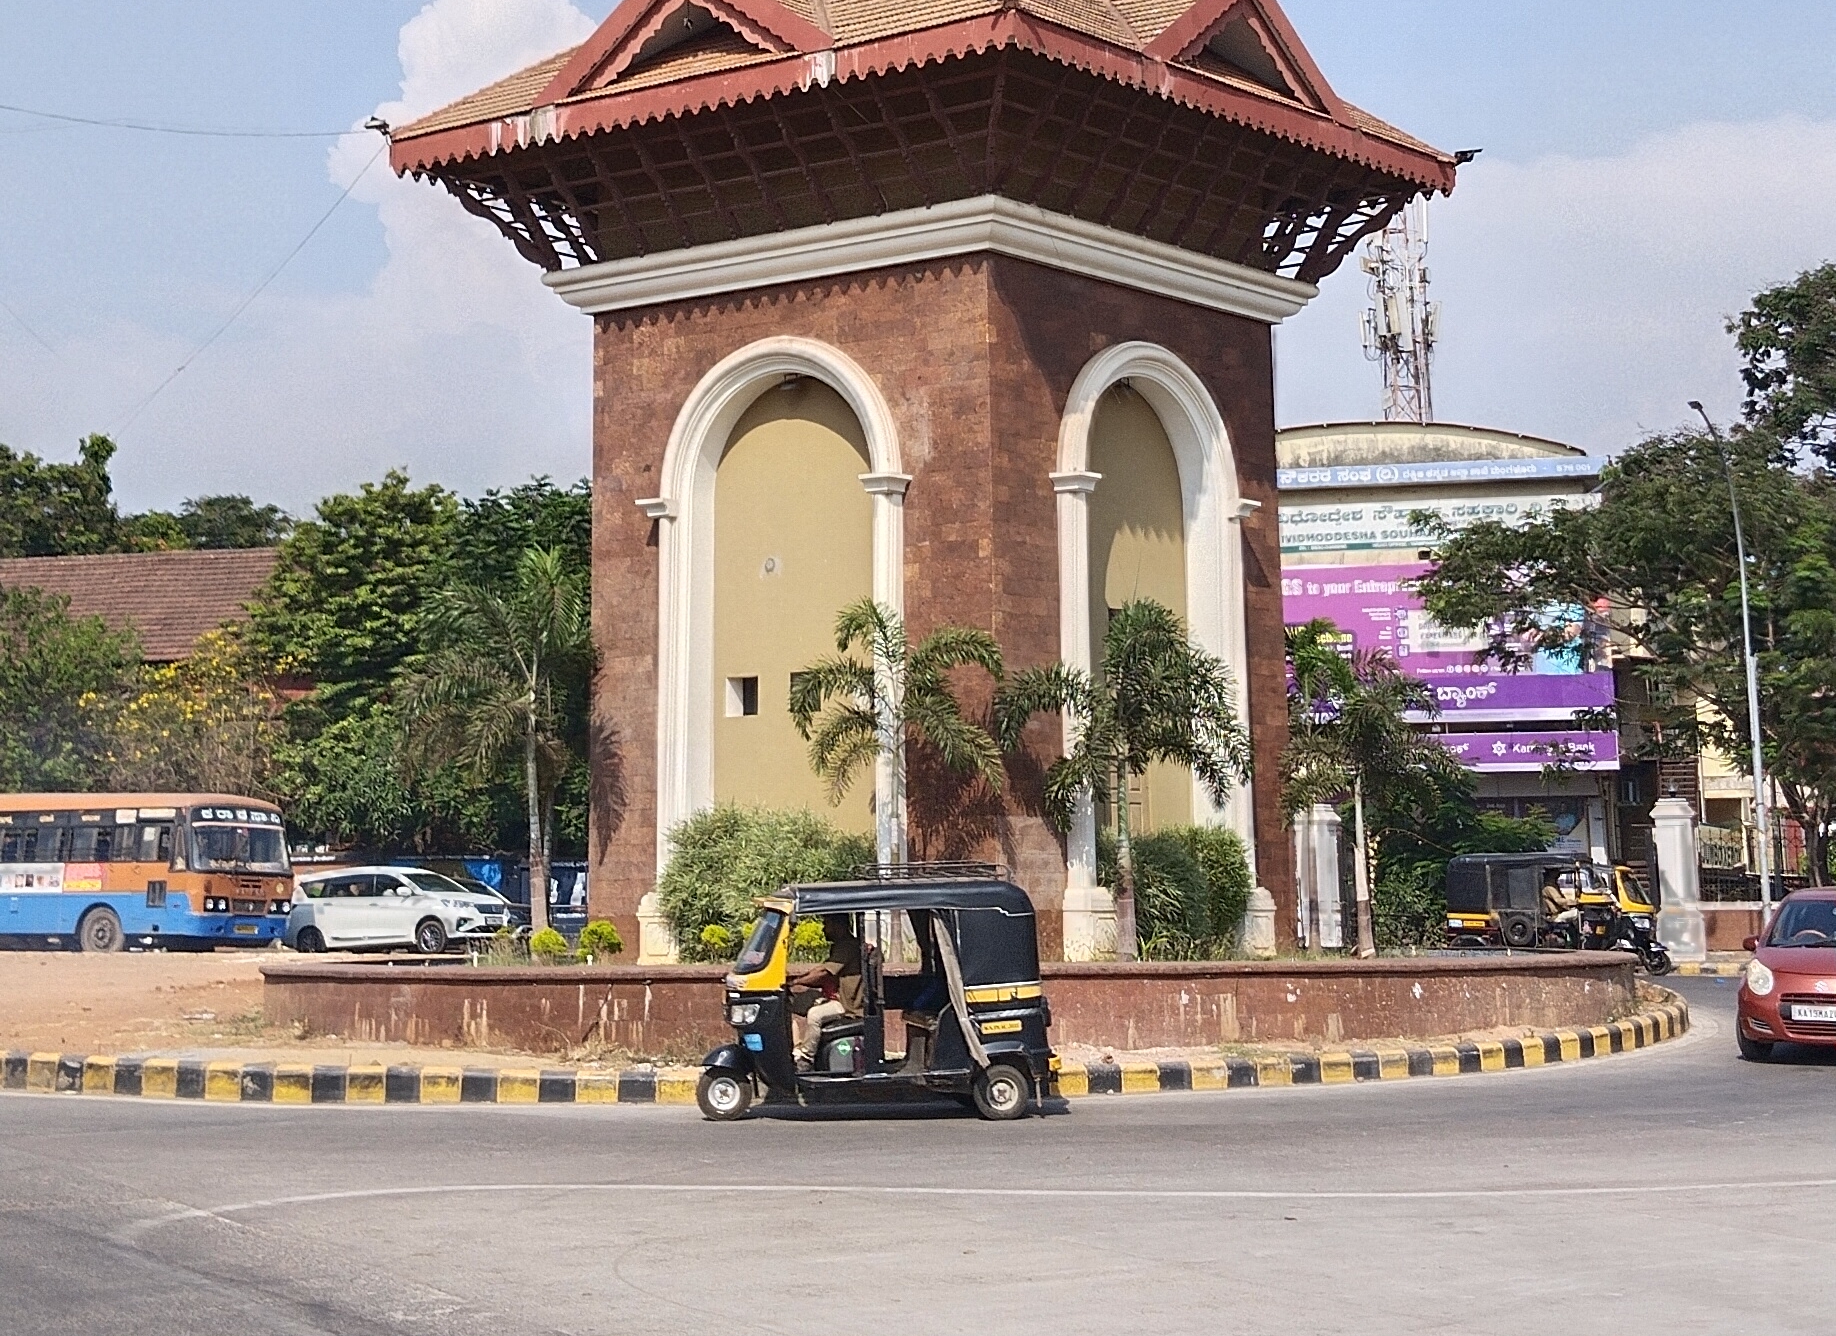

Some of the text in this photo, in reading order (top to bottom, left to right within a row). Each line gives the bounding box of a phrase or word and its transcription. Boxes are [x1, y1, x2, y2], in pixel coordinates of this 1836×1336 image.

[1337, 468, 1371, 482] ಸಂಘ
[1281, 530, 1377, 544] IVIDHODDESHA
[1281, 578, 1303, 595] GS
[1307, 581, 1320, 595] to
[1323, 582, 1351, 597] your
